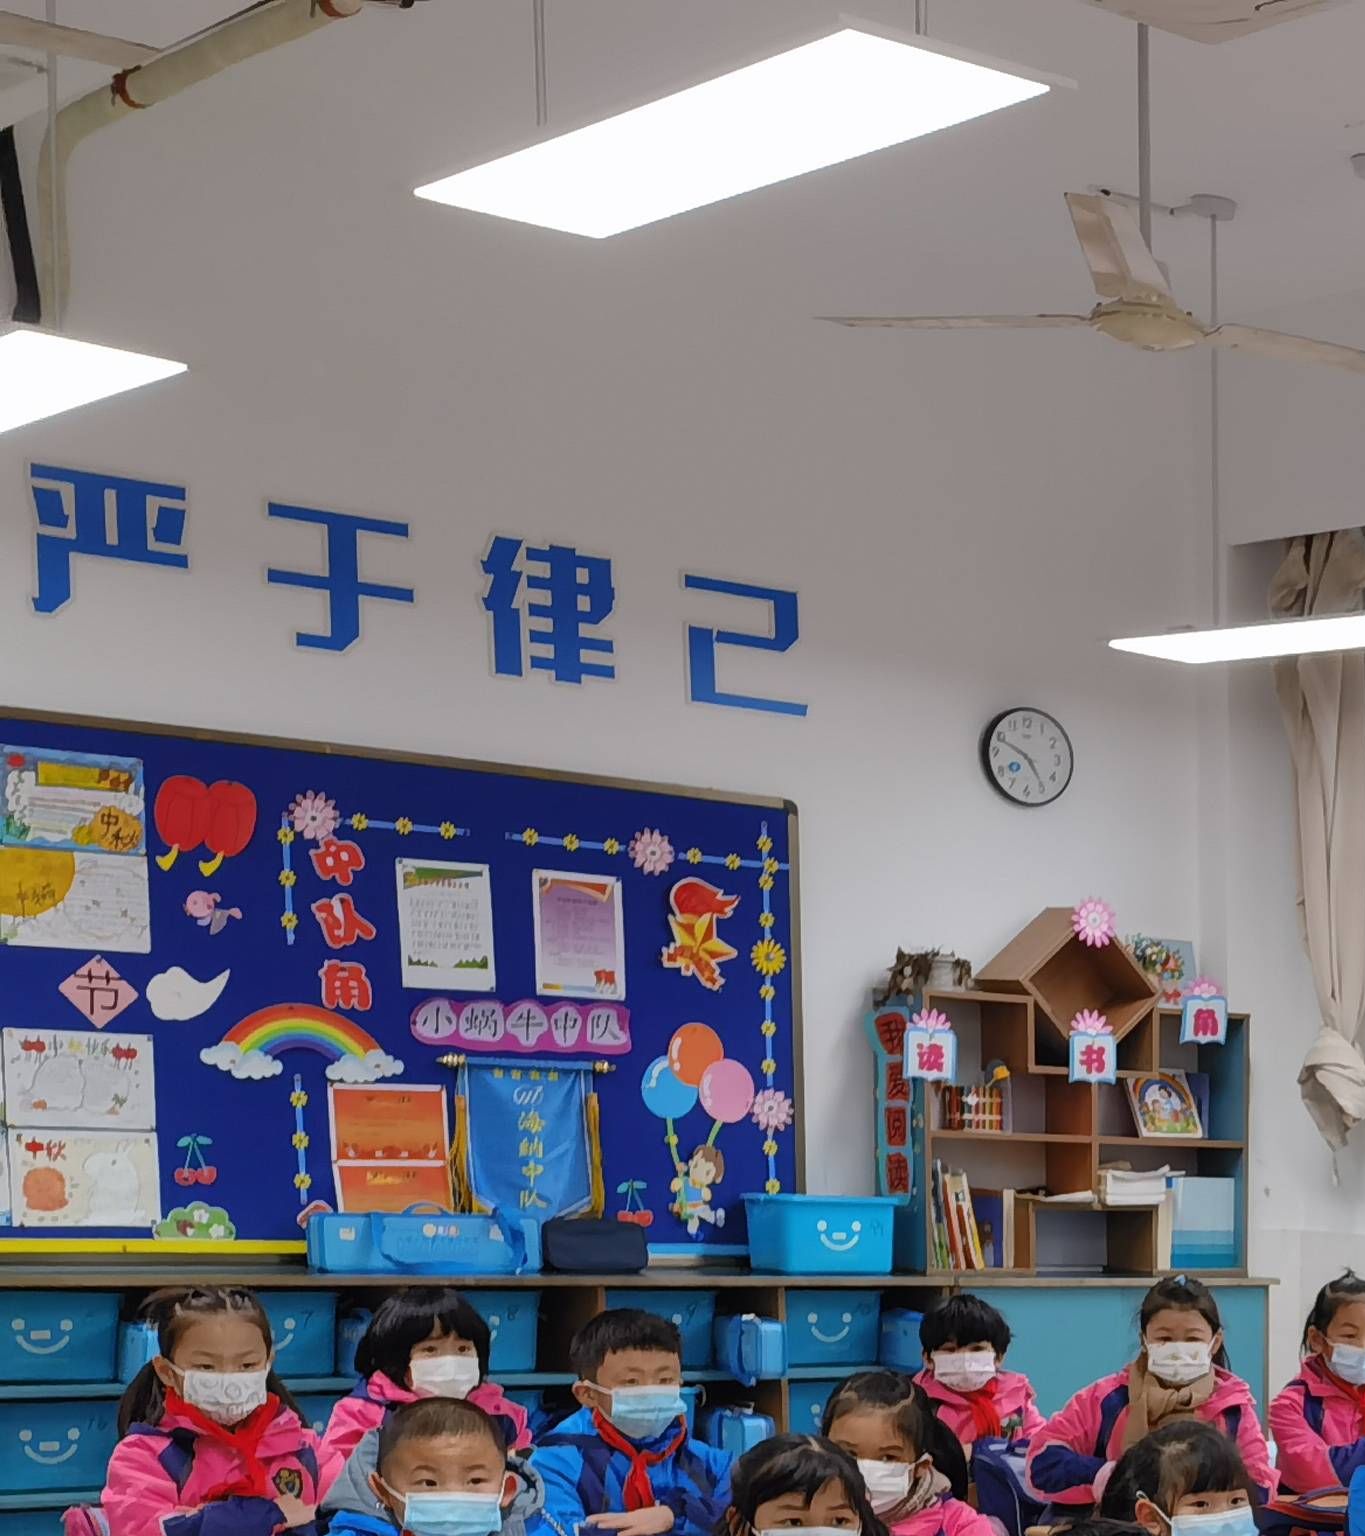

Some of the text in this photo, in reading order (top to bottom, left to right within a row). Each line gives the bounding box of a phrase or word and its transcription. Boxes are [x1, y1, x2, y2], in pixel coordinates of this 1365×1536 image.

[30, 462, 810, 716] 严于律己
[100, 810, 137, 849] 中秋
[309, 837, 376, 1010] 中队角
[74, 968, 121, 1016] 节
[422, 1004, 619, 1043] 小蜗牛中队
